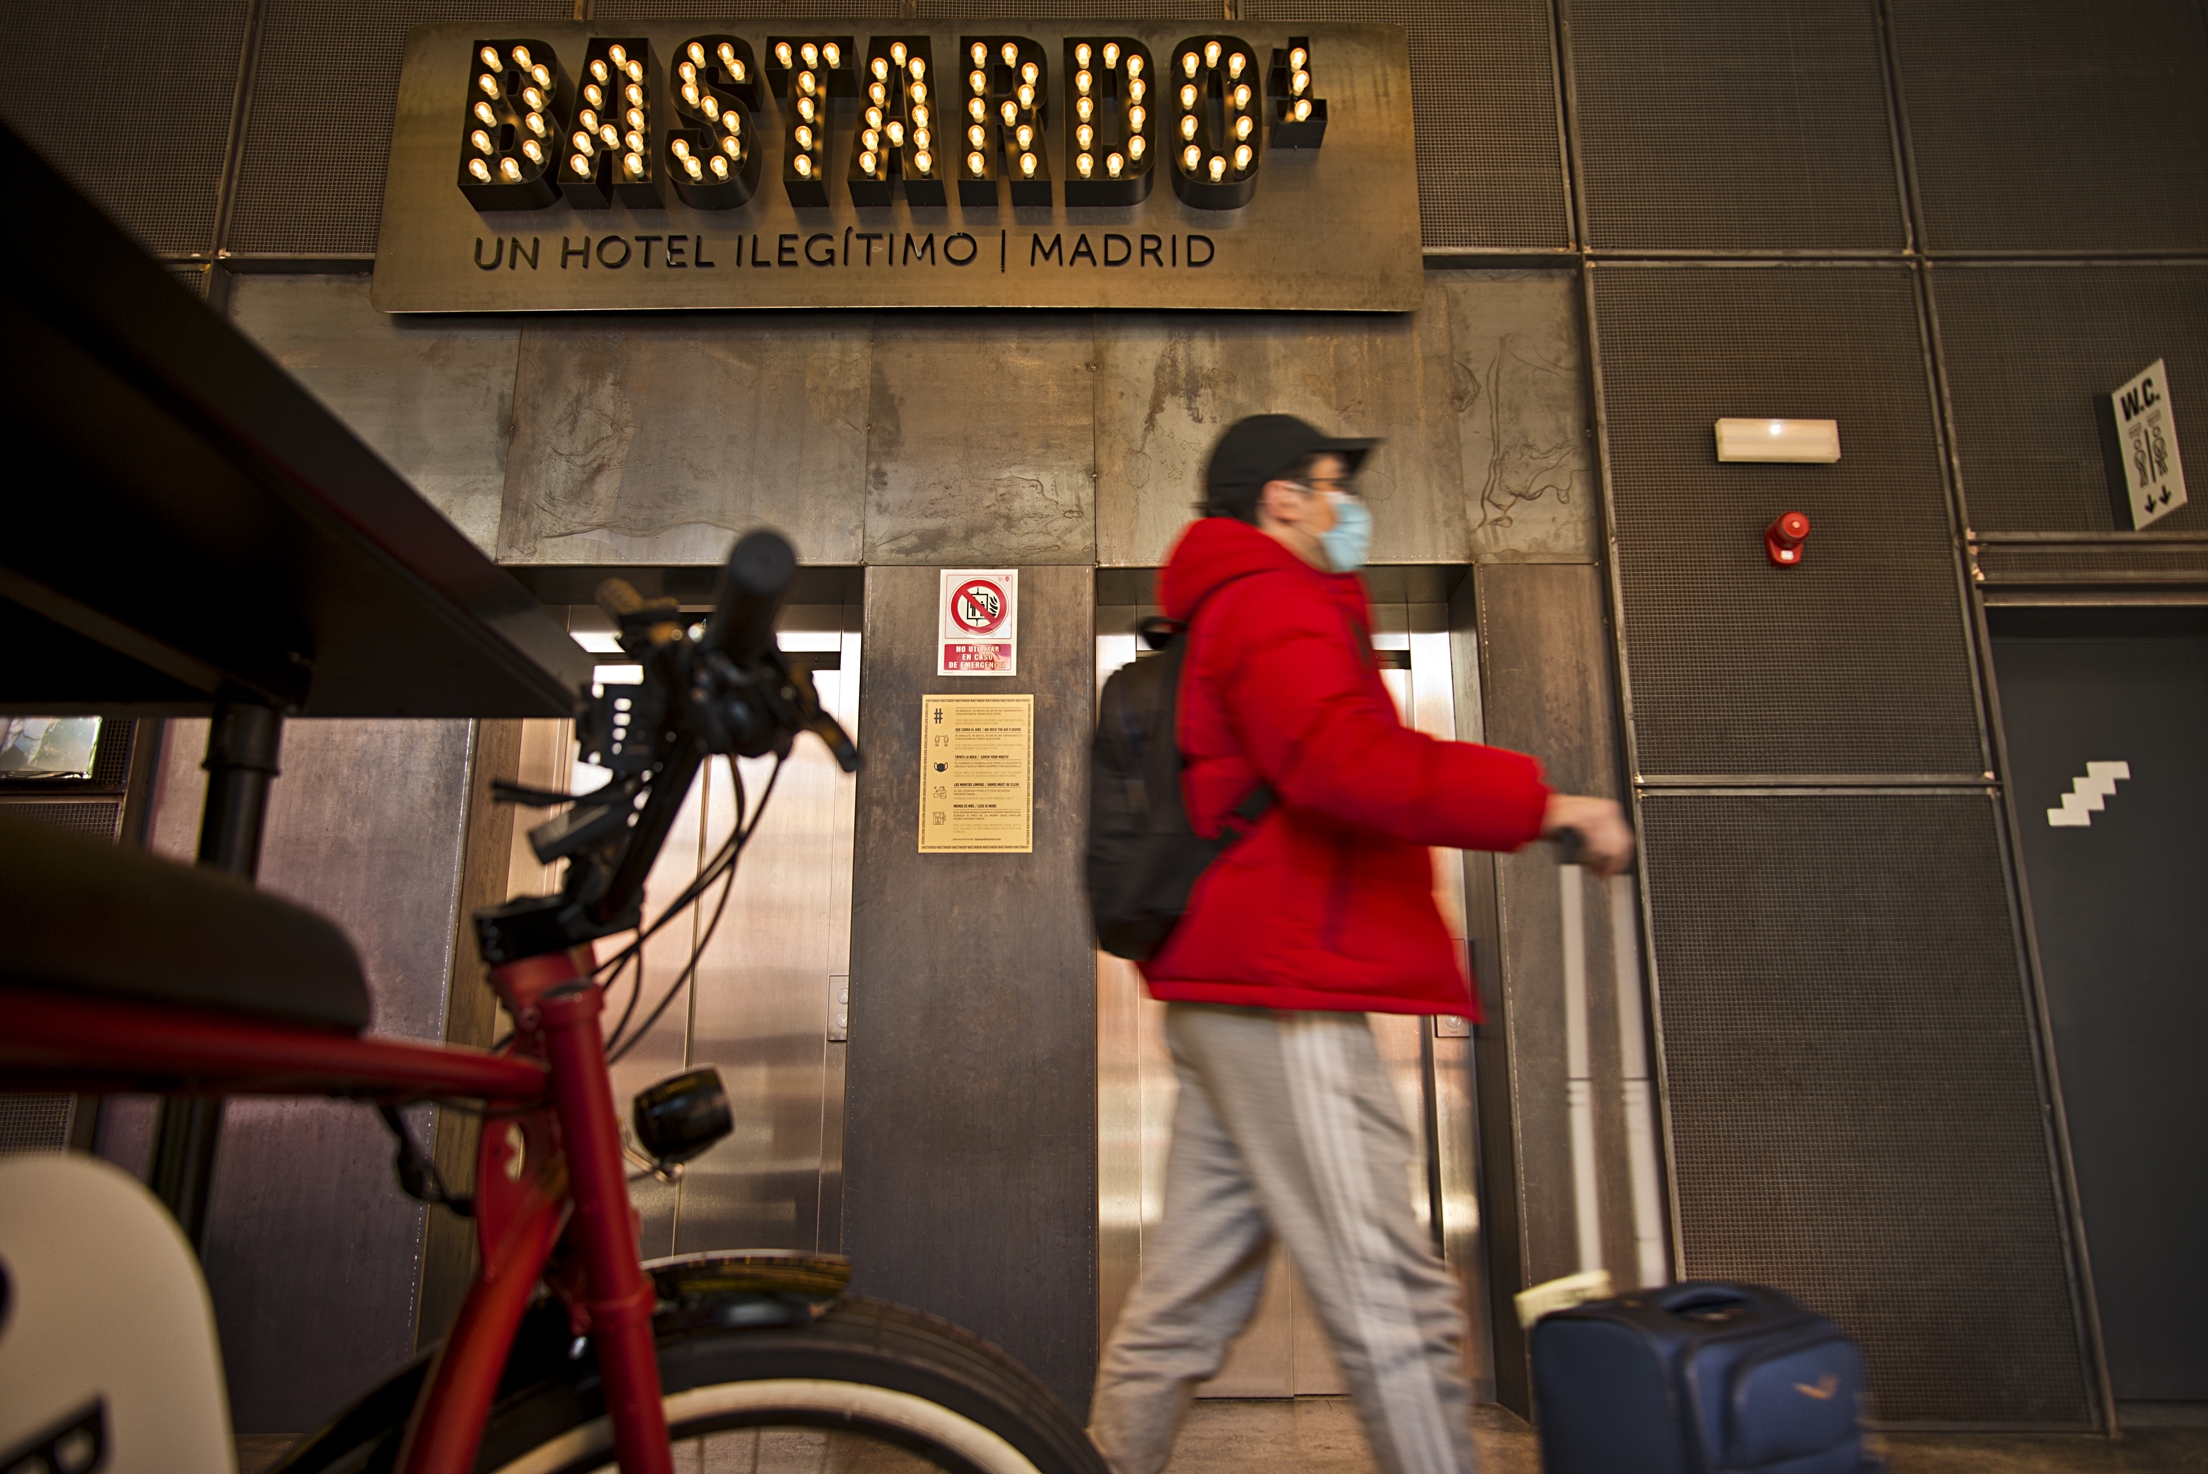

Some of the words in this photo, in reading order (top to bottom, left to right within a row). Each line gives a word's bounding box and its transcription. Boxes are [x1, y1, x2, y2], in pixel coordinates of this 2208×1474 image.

[474, 236, 540, 269] UN
[560, 234, 716, 268] HOTEL
[736, 226, 978, 268] ILEGÍTIMO
[1030, 233, 1215, 267] MADRID
[2120, 377, 2162, 422] W.C.
[956, 645, 966, 653] NO
[968, 645, 1000, 653] UTILIZAR
[962, 653, 972, 661] EN
[974, 653, 993, 661] CASO
[948, 661, 958, 669] DE
[960, 661, 1006, 669] EMERGENCIA
